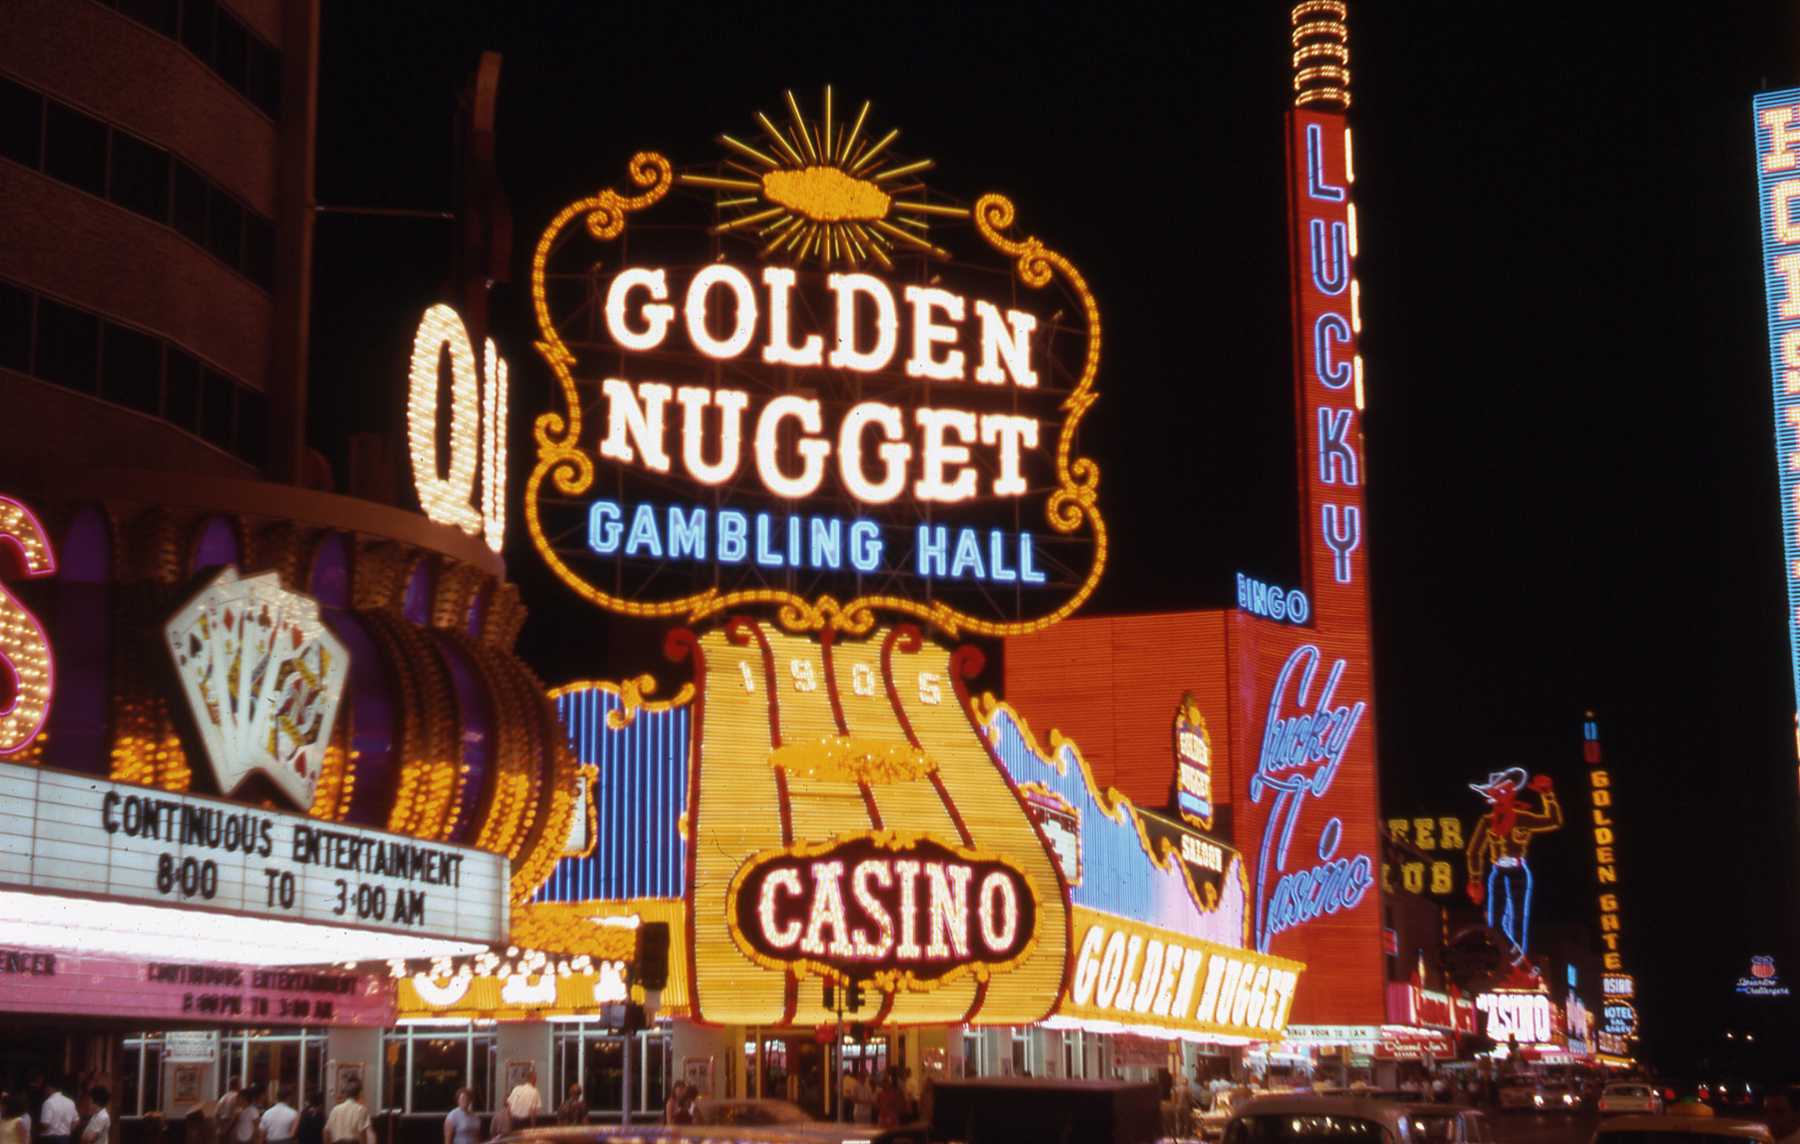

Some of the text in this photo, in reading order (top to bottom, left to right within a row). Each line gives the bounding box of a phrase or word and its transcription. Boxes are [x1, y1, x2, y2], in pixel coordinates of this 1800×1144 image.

[604, 263, 1038, 388] GOLDEN
[1306, 123, 1360, 584] LUCKY
[600, 378, 1040, 504] NUGGET
[587, 500, 1047, 583] GAMBLING HALL
[1236, 571, 1310, 624] BINGO
[737, 658, 944, 705] 1905
[102, 791, 465, 888] CONTINUOUS ENTERTAINMENT
[1589, 770, 1619, 884] GOLDEN
[157, 852, 427, 926] 8:00 TO 3:00 AM
[757, 858, 1022, 962] CASINO
[1599, 893, 1624, 971] GATE
[1073, 924, 1300, 1033] GOLDEN NUGGET
